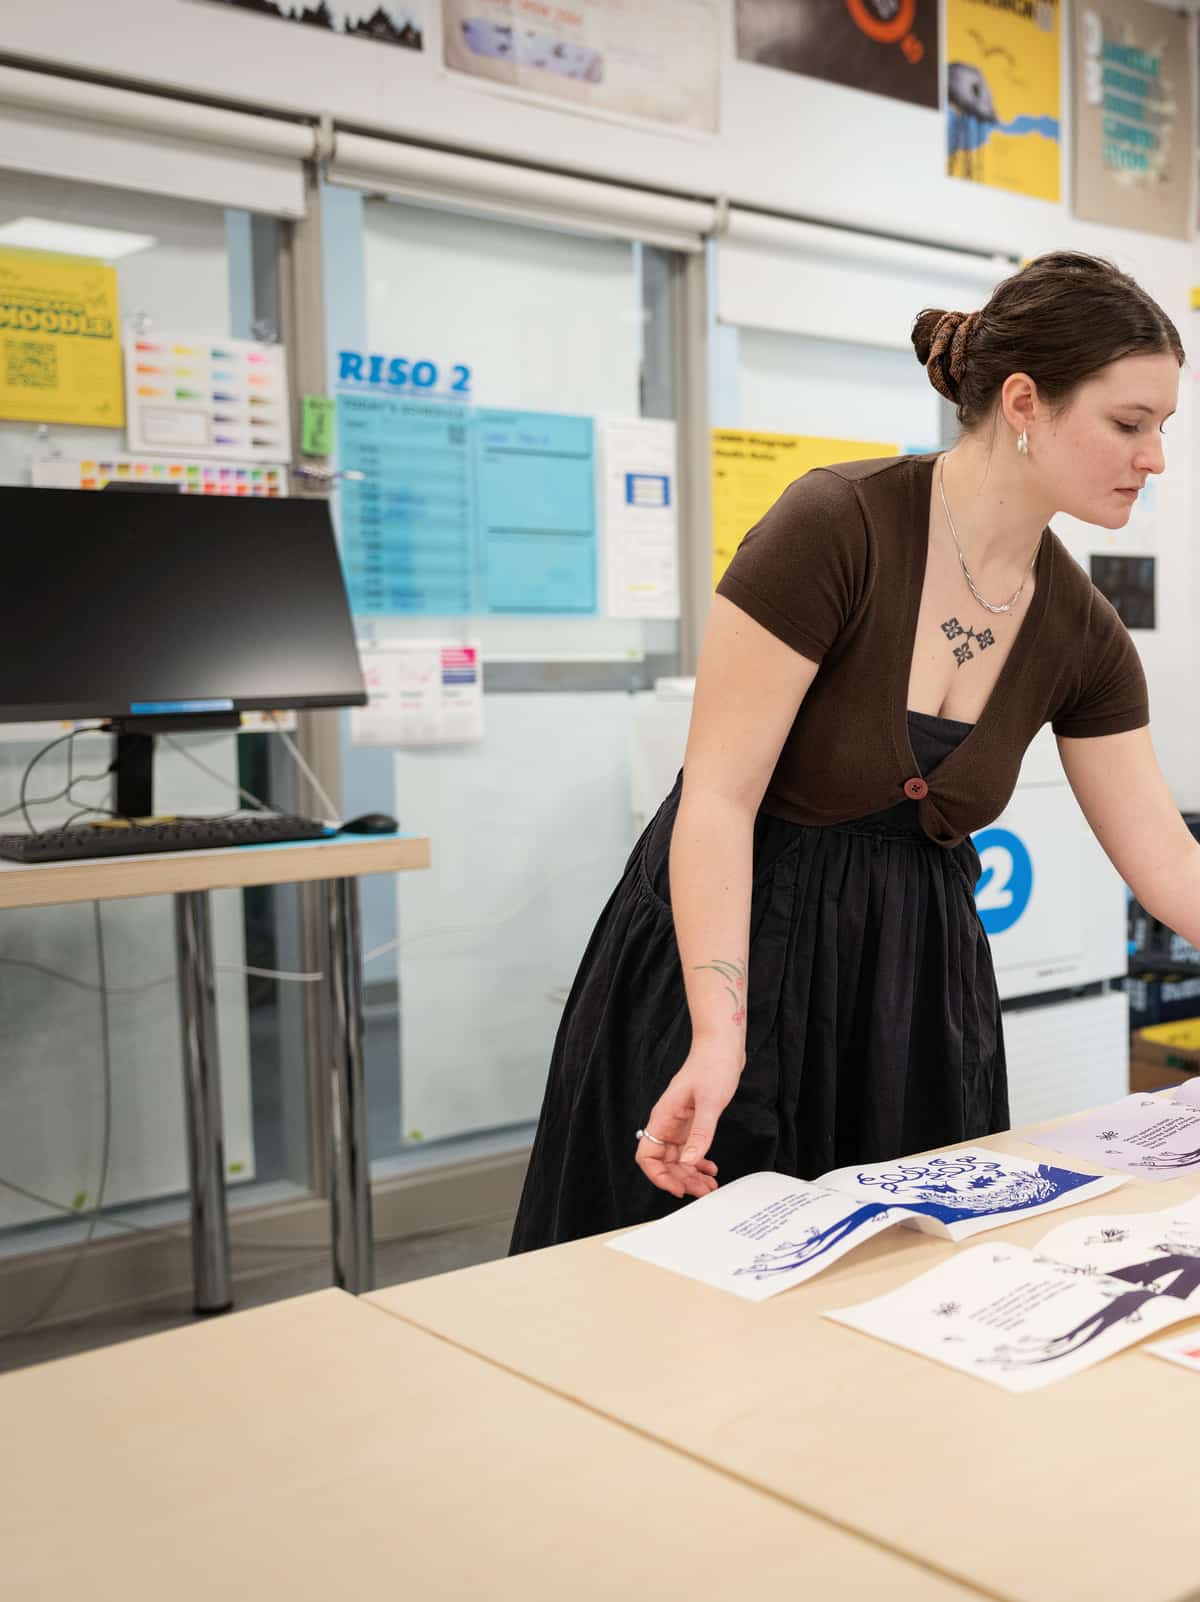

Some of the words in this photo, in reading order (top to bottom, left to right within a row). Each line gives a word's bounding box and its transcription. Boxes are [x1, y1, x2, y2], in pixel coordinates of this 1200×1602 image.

[338, 351, 438, 388] RISO
[451, 364, 471, 392] 2
[975, 845, 1015, 911] 2
